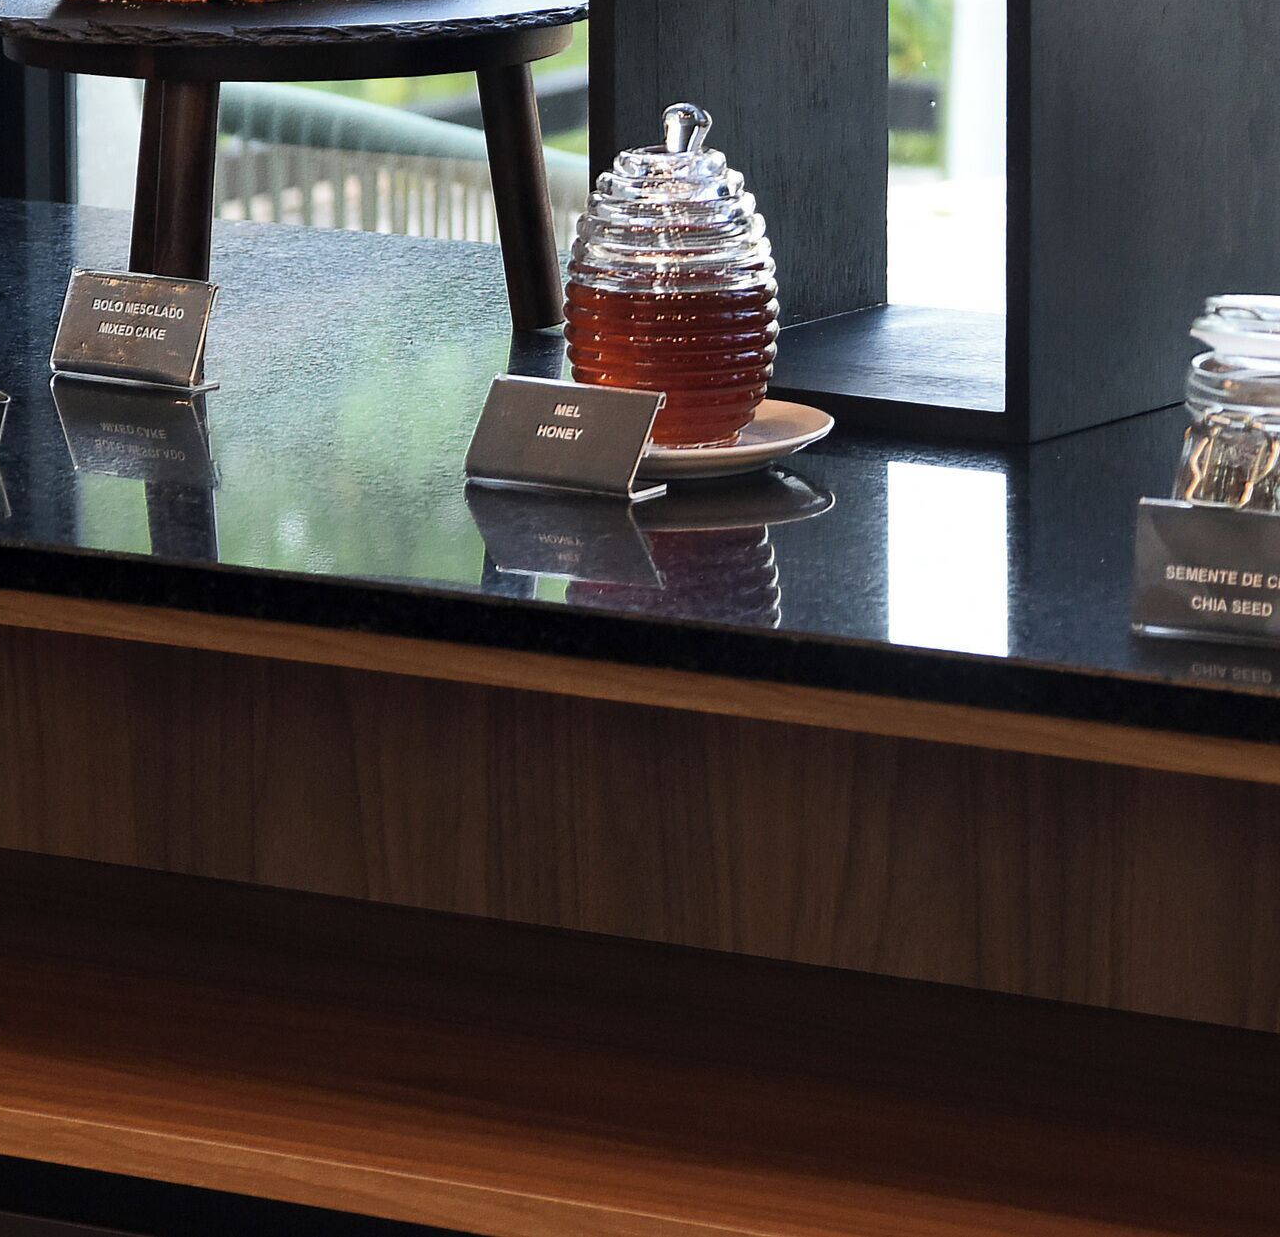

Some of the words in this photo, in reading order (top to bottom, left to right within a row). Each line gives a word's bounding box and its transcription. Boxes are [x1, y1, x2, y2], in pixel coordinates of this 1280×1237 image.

[92, 298, 123, 312] BOLO
[124, 302, 184, 320] MESCLADO
[98, 322, 134, 336] MIXED
[135, 326, 167, 340] CAKE
[554, 404, 581, 417] MEL
[536, 425, 583, 440] HONEY
[1166, 565, 1237, 585] SEMENTE
[1241, 572, 1262, 588] DE
[1191, 595, 1227, 612] CHIA
[1232, 600, 1273, 617] SEED
